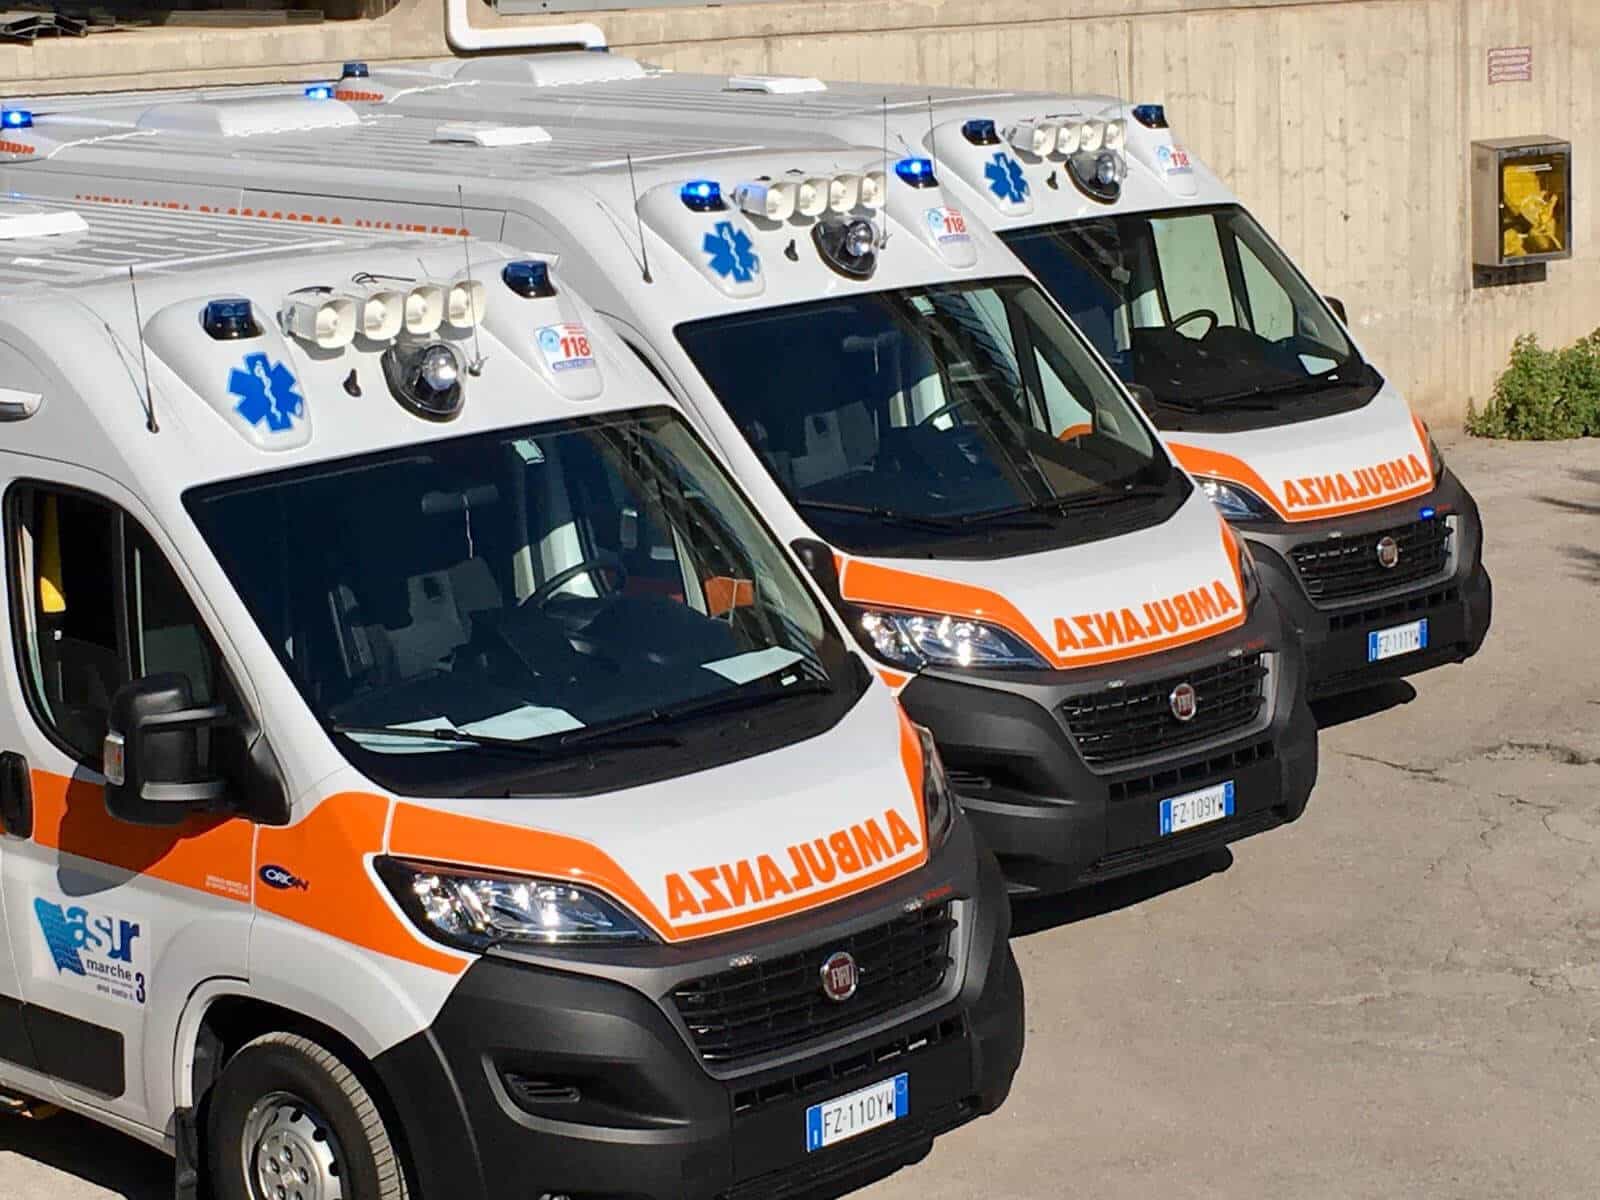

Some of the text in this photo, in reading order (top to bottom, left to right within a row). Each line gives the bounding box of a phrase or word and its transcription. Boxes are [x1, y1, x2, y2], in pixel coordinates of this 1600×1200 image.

[943, 216, 967, 234] 118
[560, 336, 592, 358] 118
[86, 958, 132, 981] marche
[135, 971, 146, 1004] 3
